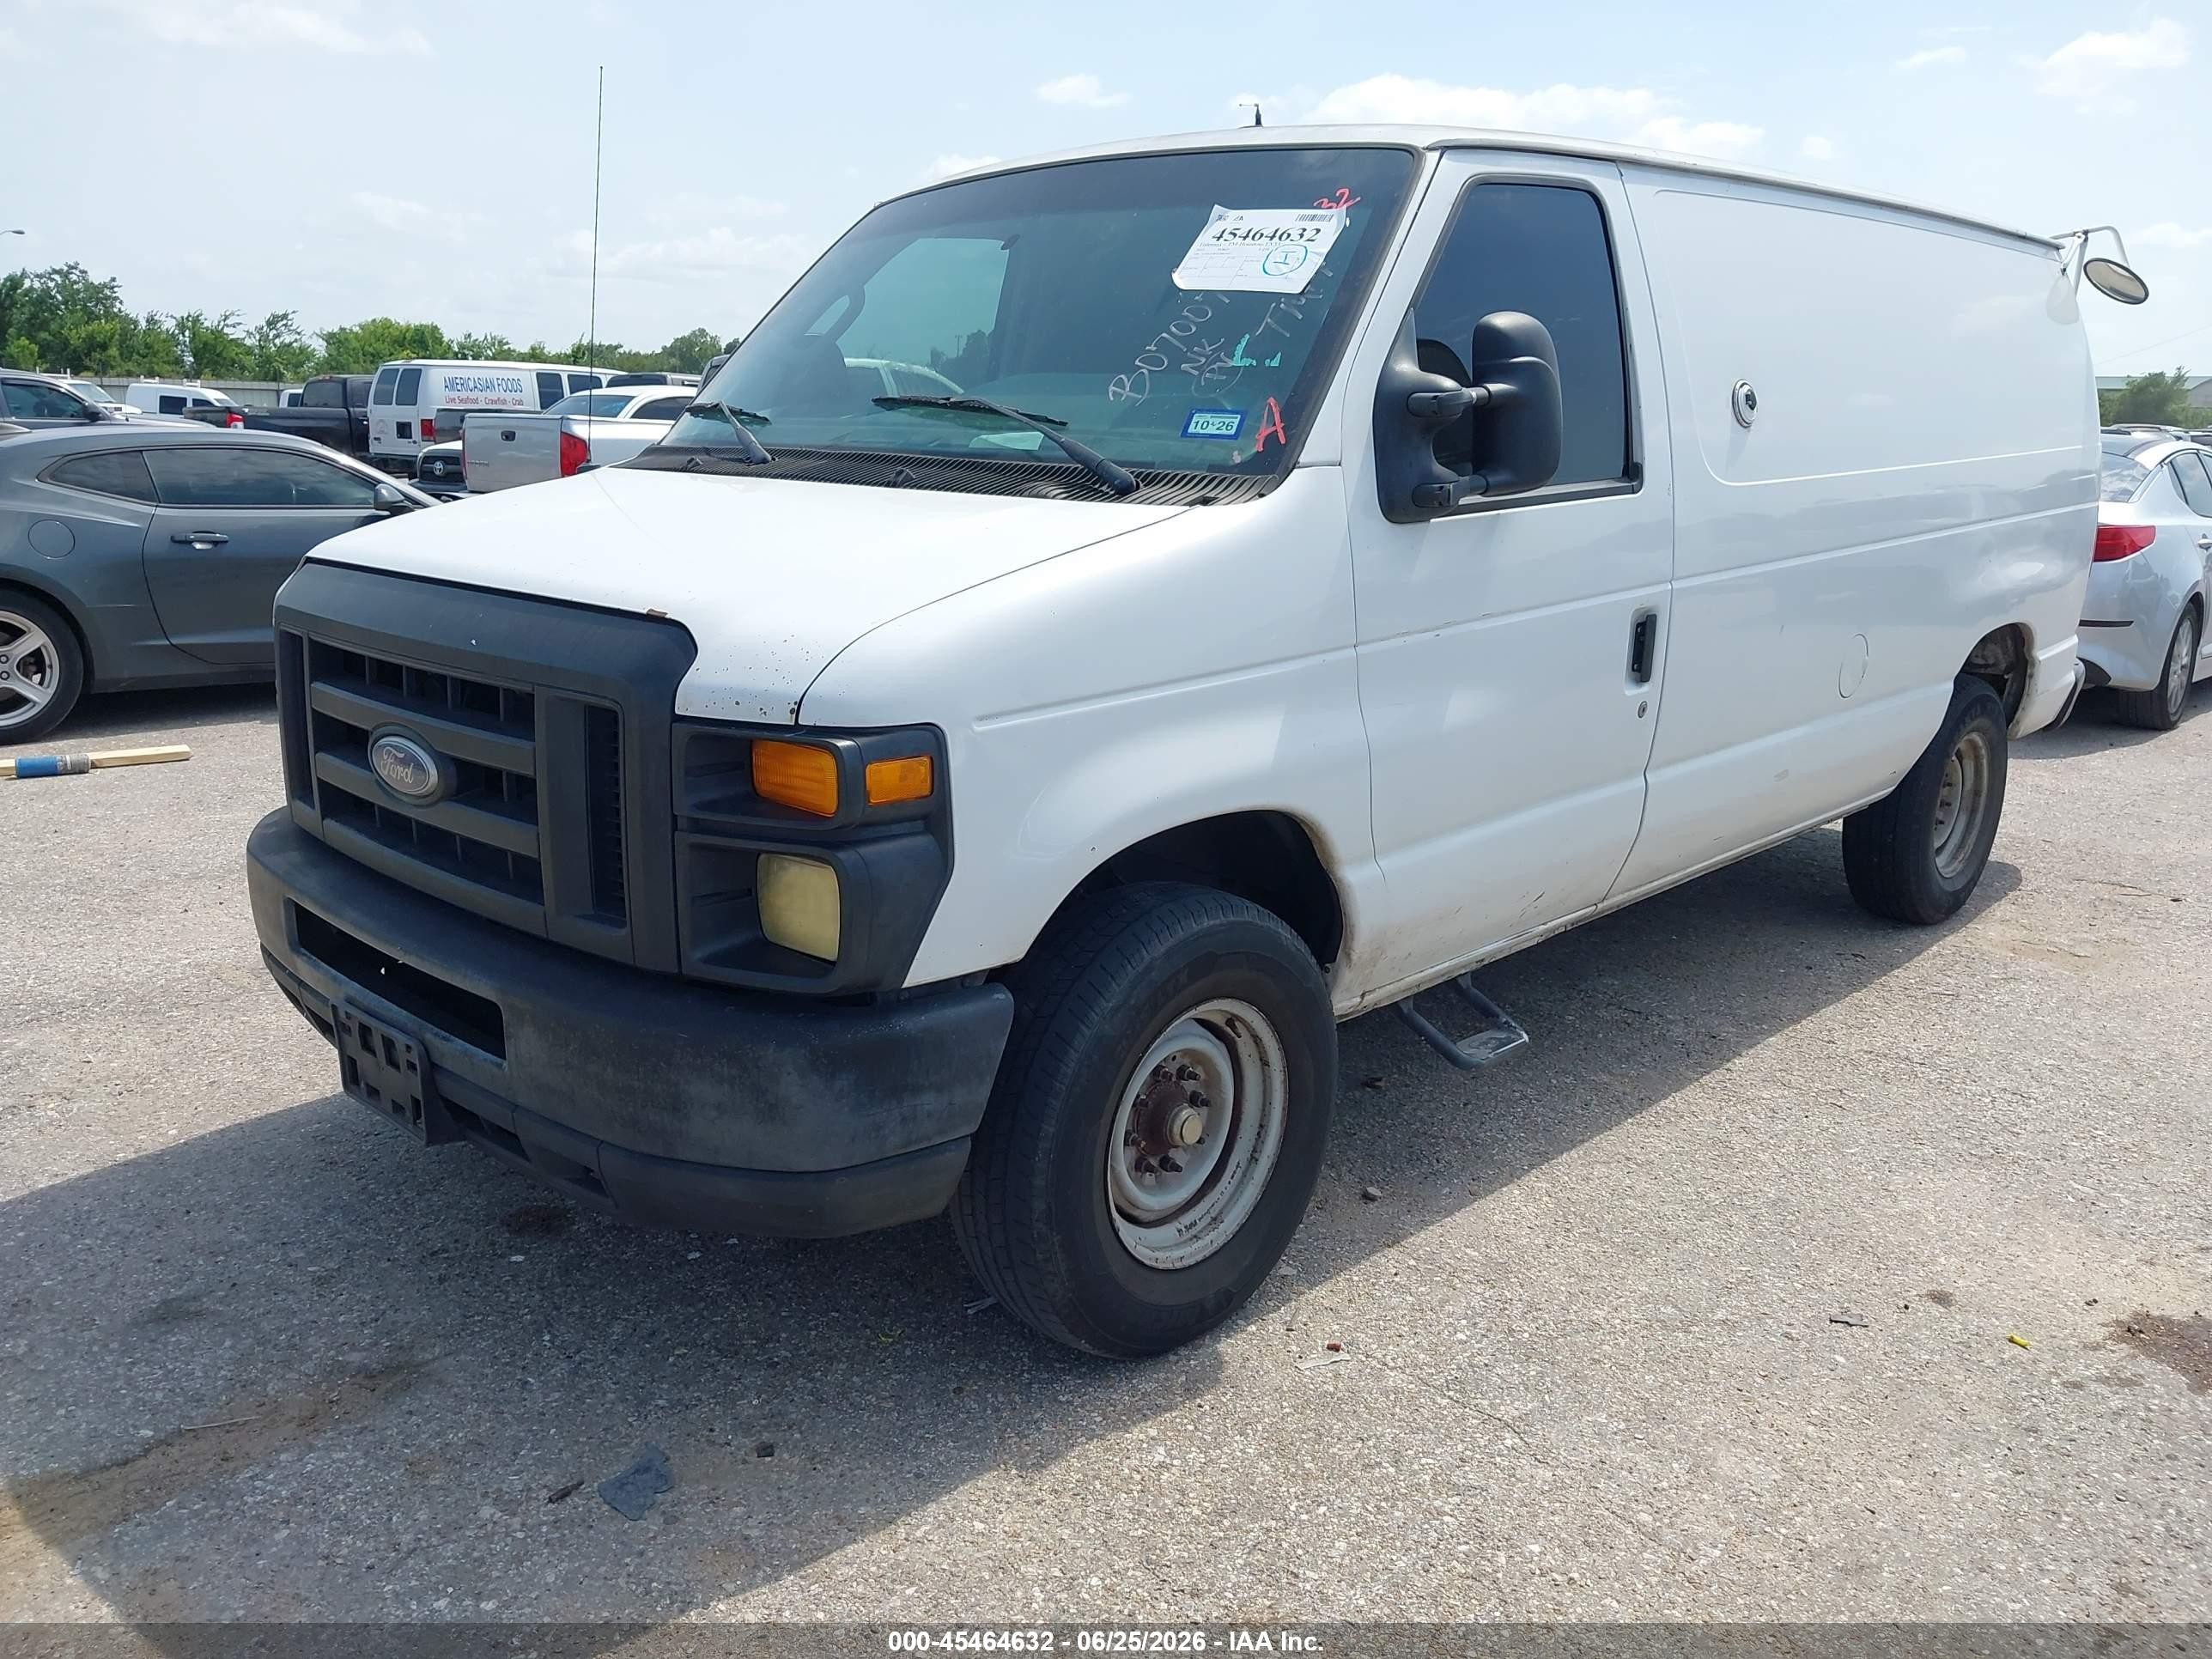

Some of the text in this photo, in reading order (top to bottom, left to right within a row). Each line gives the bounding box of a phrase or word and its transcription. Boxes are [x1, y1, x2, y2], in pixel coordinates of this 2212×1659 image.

[1212, 227, 1322, 242] 45464632
[443, 376, 523, 393] AMERICASIAN FOODS
[446, 395, 524, 406] Live Seafood Crawfish Crab
[1255, 398, 1285, 452] A
[380, 746, 415, 784] Ford
